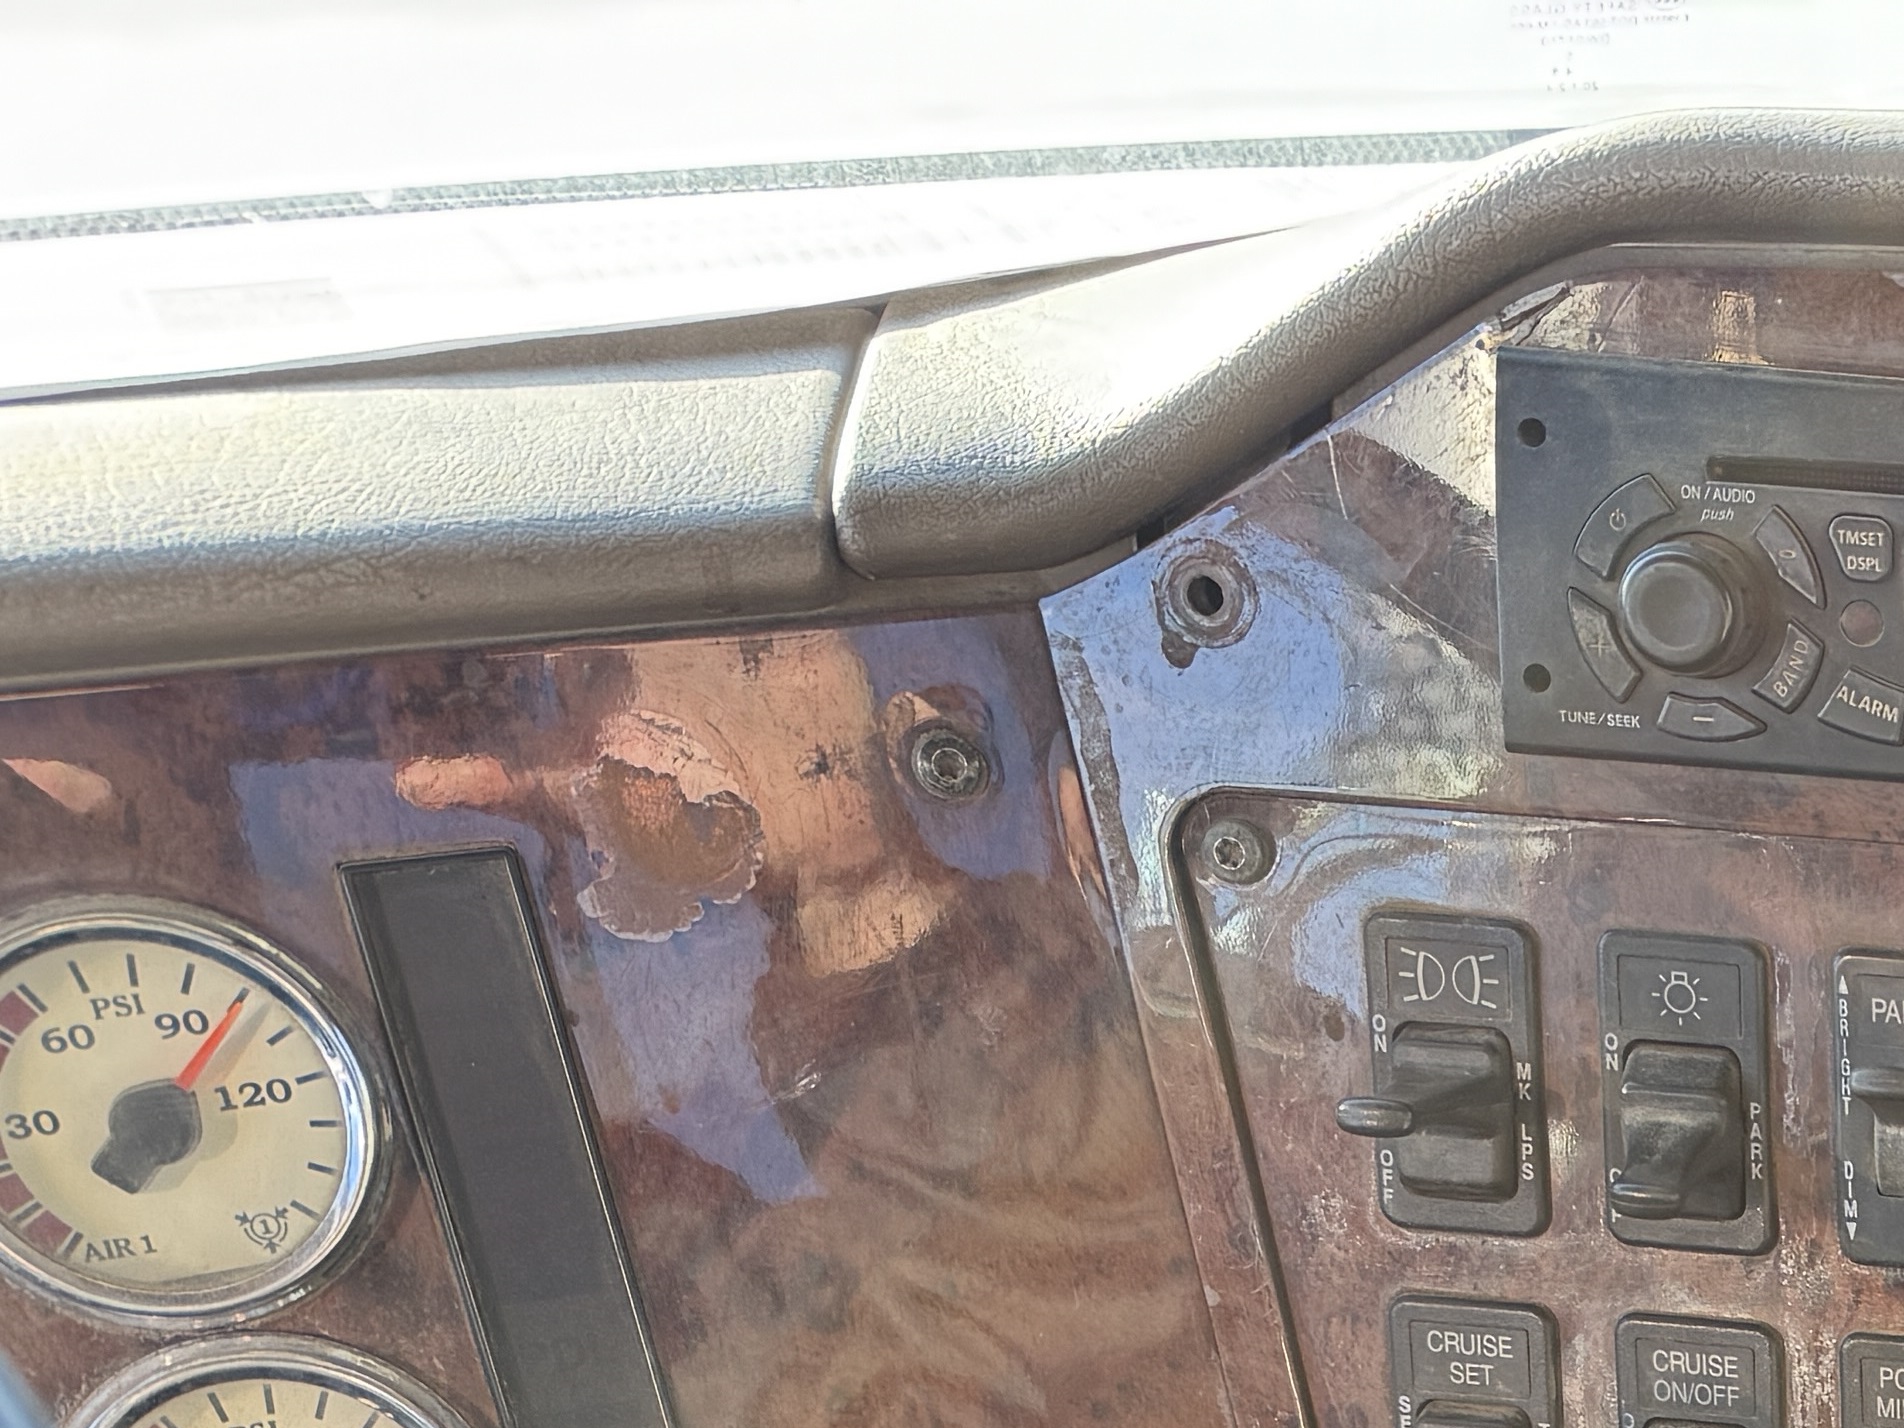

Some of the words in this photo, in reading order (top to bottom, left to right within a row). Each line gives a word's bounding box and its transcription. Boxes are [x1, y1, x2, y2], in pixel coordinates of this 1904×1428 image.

[1680, 485, 1701, 499] ON
[1713, 488, 1756, 503] AUDIO
[1701, 508, 1734, 522] push
[1837, 530, 1884, 547] TMSET
[1847, 556, 1883, 572] DSPL
[1774, 639, 1809, 697] BAND
[1559, 710, 1641, 728] TUNE/SEEK
[1836, 685, 1899, 723] ALARM
[91, 993, 145, 1021] PSI
[40, 1024, 95, 1055] 60
[154, 1008, 209, 1040] 90
[1838, 999, 1851, 1117] BRIGHT
[214, 1078, 292, 1112] 120
[4, 1109, 60, 1140] 30
[1749, 1102, 1764, 1181] PARK
[1842, 1160, 1857, 1220] DIM
[85, 1237, 135, 1263] AIR
[140, 1234, 157, 1254] 1
[1426, 1329, 1513, 1360] CRUISE
[1449, 1362, 1493, 1388] SET
[1652, 1349, 1740, 1380] CRUISE
[1653, 1379, 1740, 1408] ON/OFF
